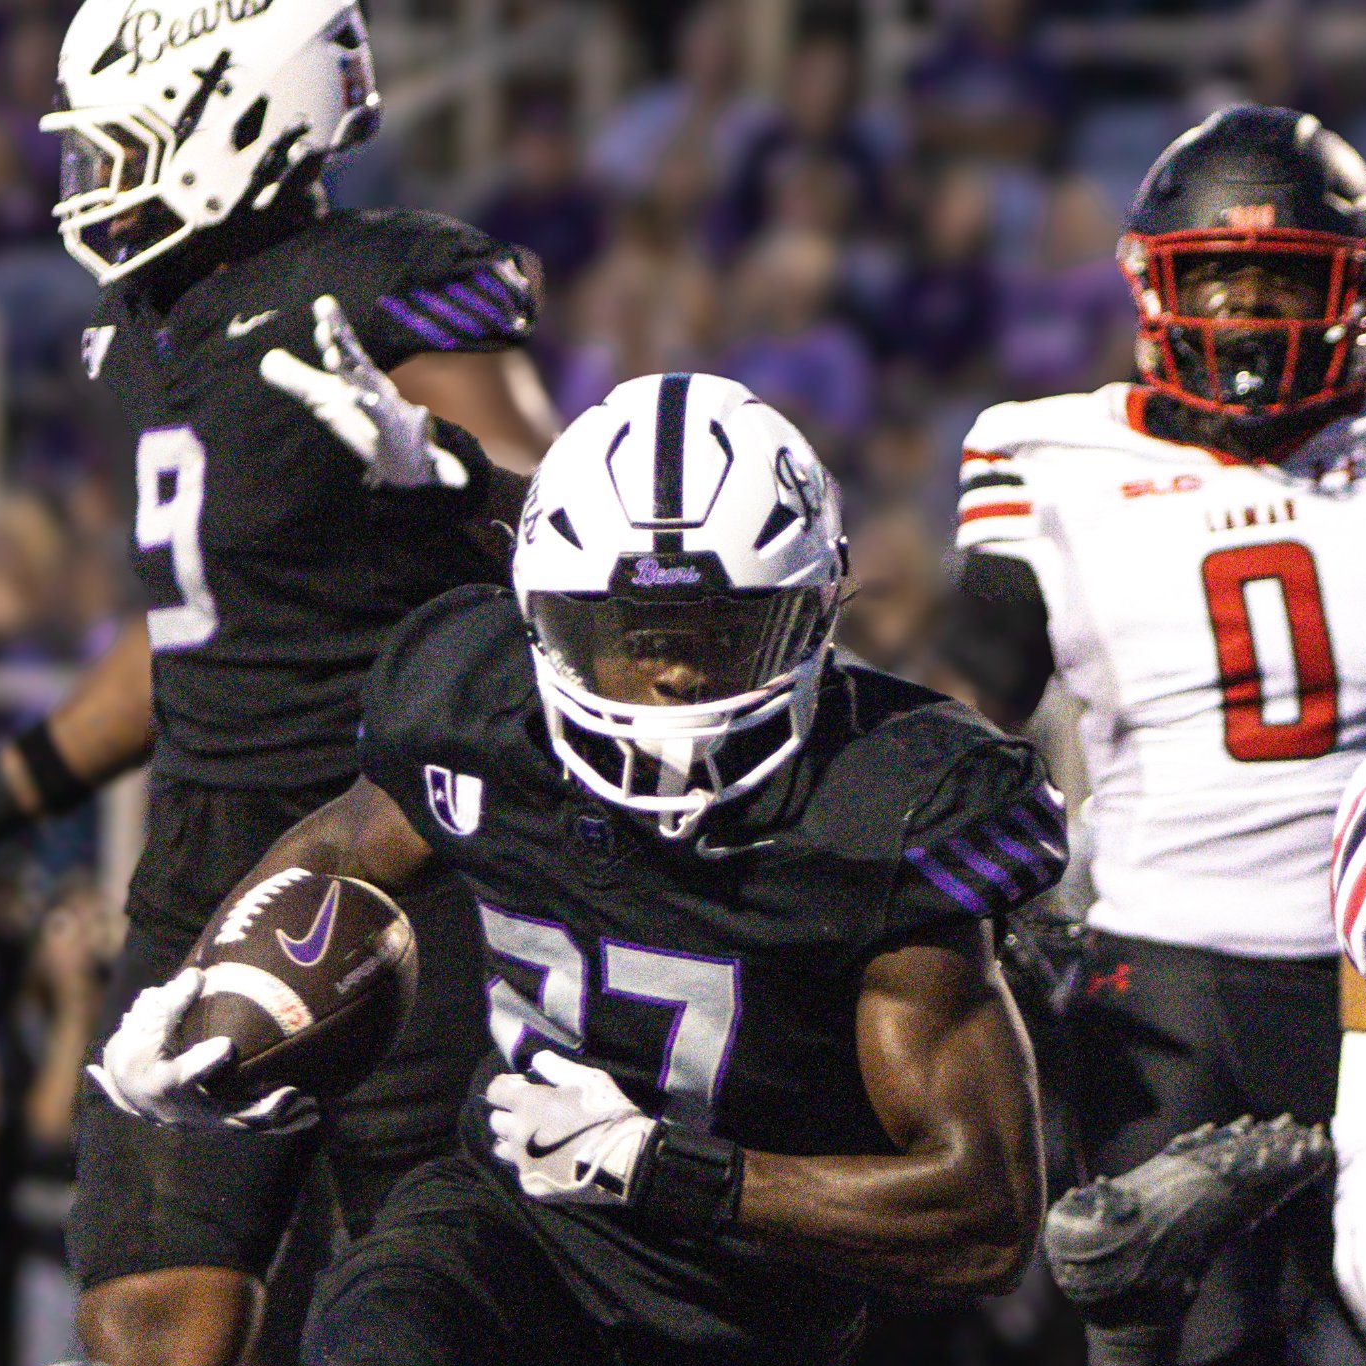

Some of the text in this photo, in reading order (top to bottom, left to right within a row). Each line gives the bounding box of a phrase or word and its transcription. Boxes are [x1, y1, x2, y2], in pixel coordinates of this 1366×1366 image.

[135, 426, 218, 653] 9
[1201, 539, 1338, 763] 0
[475, 895, 742, 1130] 27
